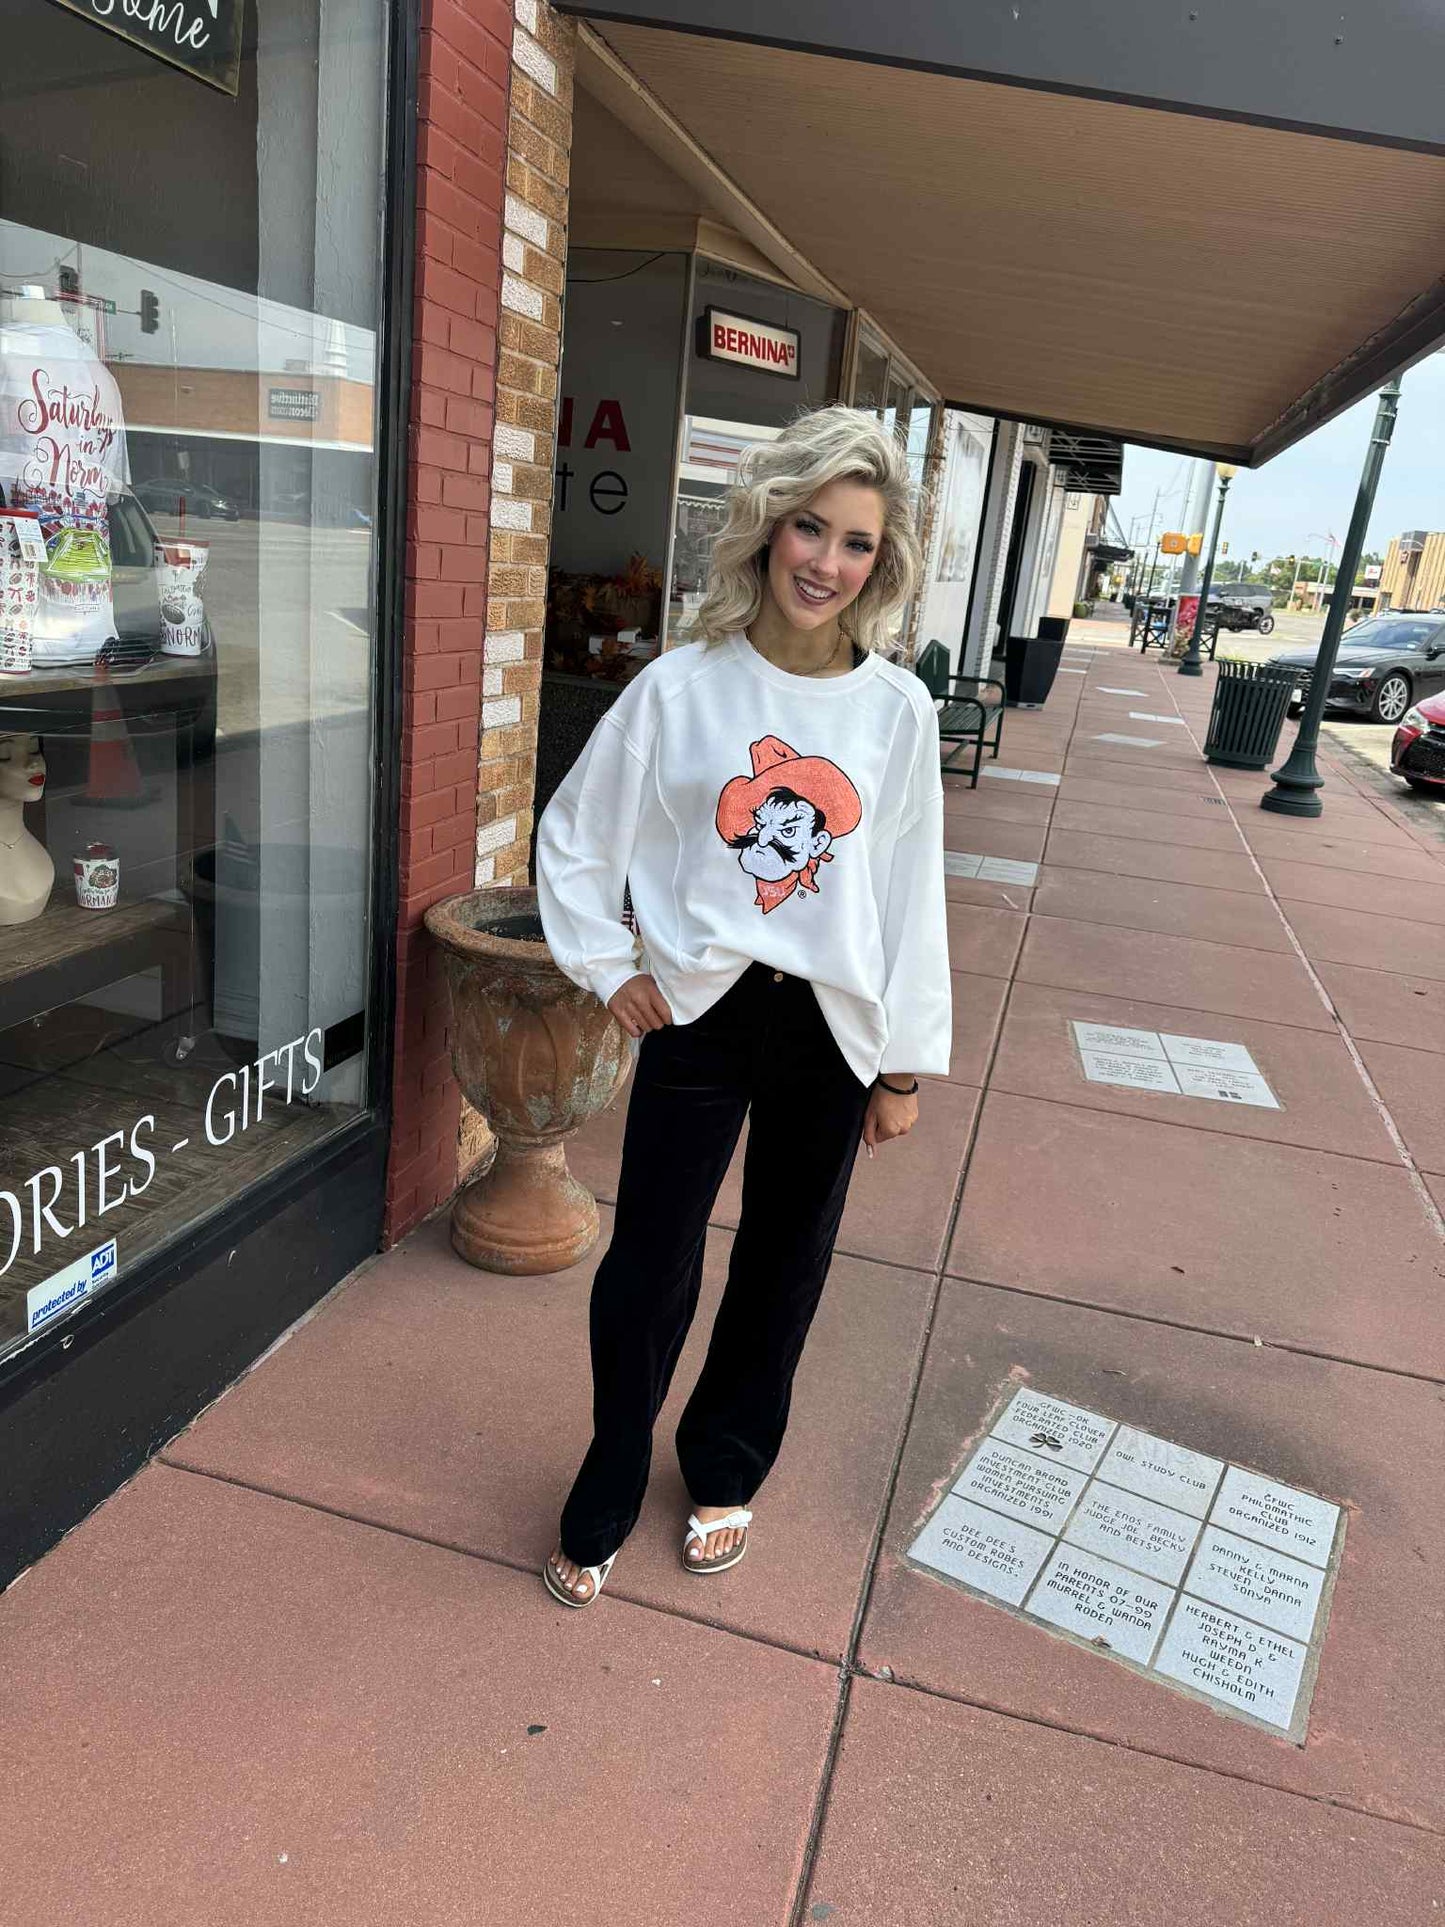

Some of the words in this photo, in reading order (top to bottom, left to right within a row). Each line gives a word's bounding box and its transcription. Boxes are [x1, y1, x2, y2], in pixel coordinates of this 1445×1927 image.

[714, 324, 789, 366] BERNINA
[78, 435, 97, 455] in
[205, 1028, 321, 1146] GIFTS
[92, 1247, 115, 1274] ADT
[32, 1283, 76, 1324] protected
[76, 1279, 87, 1295] by
[1012, 1415, 1065, 1439] ORGANIZED
[1015, 1408, 1068, 1432] FEDERATED
[1073, 1431, 1098, 1444] CLUB
[1016, 1401, 1040, 1414] FOUR
[1043, 1411, 1065, 1423] LEAF
[1069, 1421, 1106, 1438] CLOVER
[976, 1464, 1012, 1483] WOMEN
[1016, 1480, 1066, 1505] PURSUING
[980, 1456, 1040, 1482] INVESTMENT
[1045, 1482, 1071, 1497] CLUB
[992, 1452, 1032, 1472] DUNCAN
[1035, 1470, 1068, 1487] BROAD
[1116, 1450, 1136, 1463] OWL
[1141, 1460, 1176, 1477] STUDY
[1180, 1476, 1206, 1490] CLUB
[970, 1481, 1027, 1508] ORGANIZED
[1030, 1505, 1054, 1519] 1991
[982, 1475, 1050, 1508] INVESTMENTS
[1092, 1500, 1110, 1512] THE
[1147, 1523, 1186, 1543] FAMILY
[1228, 1507, 1289, 1535] ORGANIZED
[1294, 1532, 1316, 1546] 1912
[1241, 1494, 1314, 1527] PHILOMATHIC
[1260, 1510, 1288, 1526] CLUB
[942, 1538, 964, 1552] AND
[943, 1528, 987, 1552] CUSTOM
[990, 1548, 1024, 1569] ROBES
[961, 1524, 980, 1538] DEE
[986, 1535, 1017, 1553] DEE'S
[1084, 1508, 1118, 1526] JUDGE
[1150, 1534, 1186, 1553] BECKY
[1100, 1524, 1121, 1536] AND
[1126, 1534, 1162, 1552] BETSY
[1054, 1571, 1104, 1598] PARENTS
[1058, 1561, 1070, 1572] IN
[1073, 1568, 1112, 1590] HONOR
[1116, 1586, 1130, 1597] OF
[1135, 1595, 1159, 1610] OUR
[1210, 1564, 1252, 1586] STEVEN
[1264, 1585, 1302, 1607] DANNA
[1212, 1544, 1250, 1564] DANNY
[1270, 1568, 1309, 1590] MARNA
[1240, 1566, 1275, 1584] KELLY
[1046, 1579, 1091, 1605] MURREL
[1097, 1601, 1106, 1610] &
[1112, 1608, 1152, 1631] WANDA
[1233, 1583, 1272, 1604] SONYA
[1074, 1602, 1114, 1626] RODEN
[1186, 1604, 1240, 1633] HERBERT
[1244, 1631, 1252, 1640] &
[1258, 1636, 1296, 1659] ETHEL
[1198, 1622, 1242, 1647] JOSEPH
[1248, 1644, 1257, 1652] D
[1268, 1653, 1277, 1662] &
[1202, 1635, 1247, 1660] RAYMA
[1254, 1658, 1264, 1668] K
[1182, 1650, 1216, 1671] HUGH
[1222, 1668, 1230, 1677] &
[1236, 1675, 1275, 1698] EDITH
[1210, 1650, 1252, 1675] WEEDN
[1193, 1668, 1256, 1702] CHISHOLM
